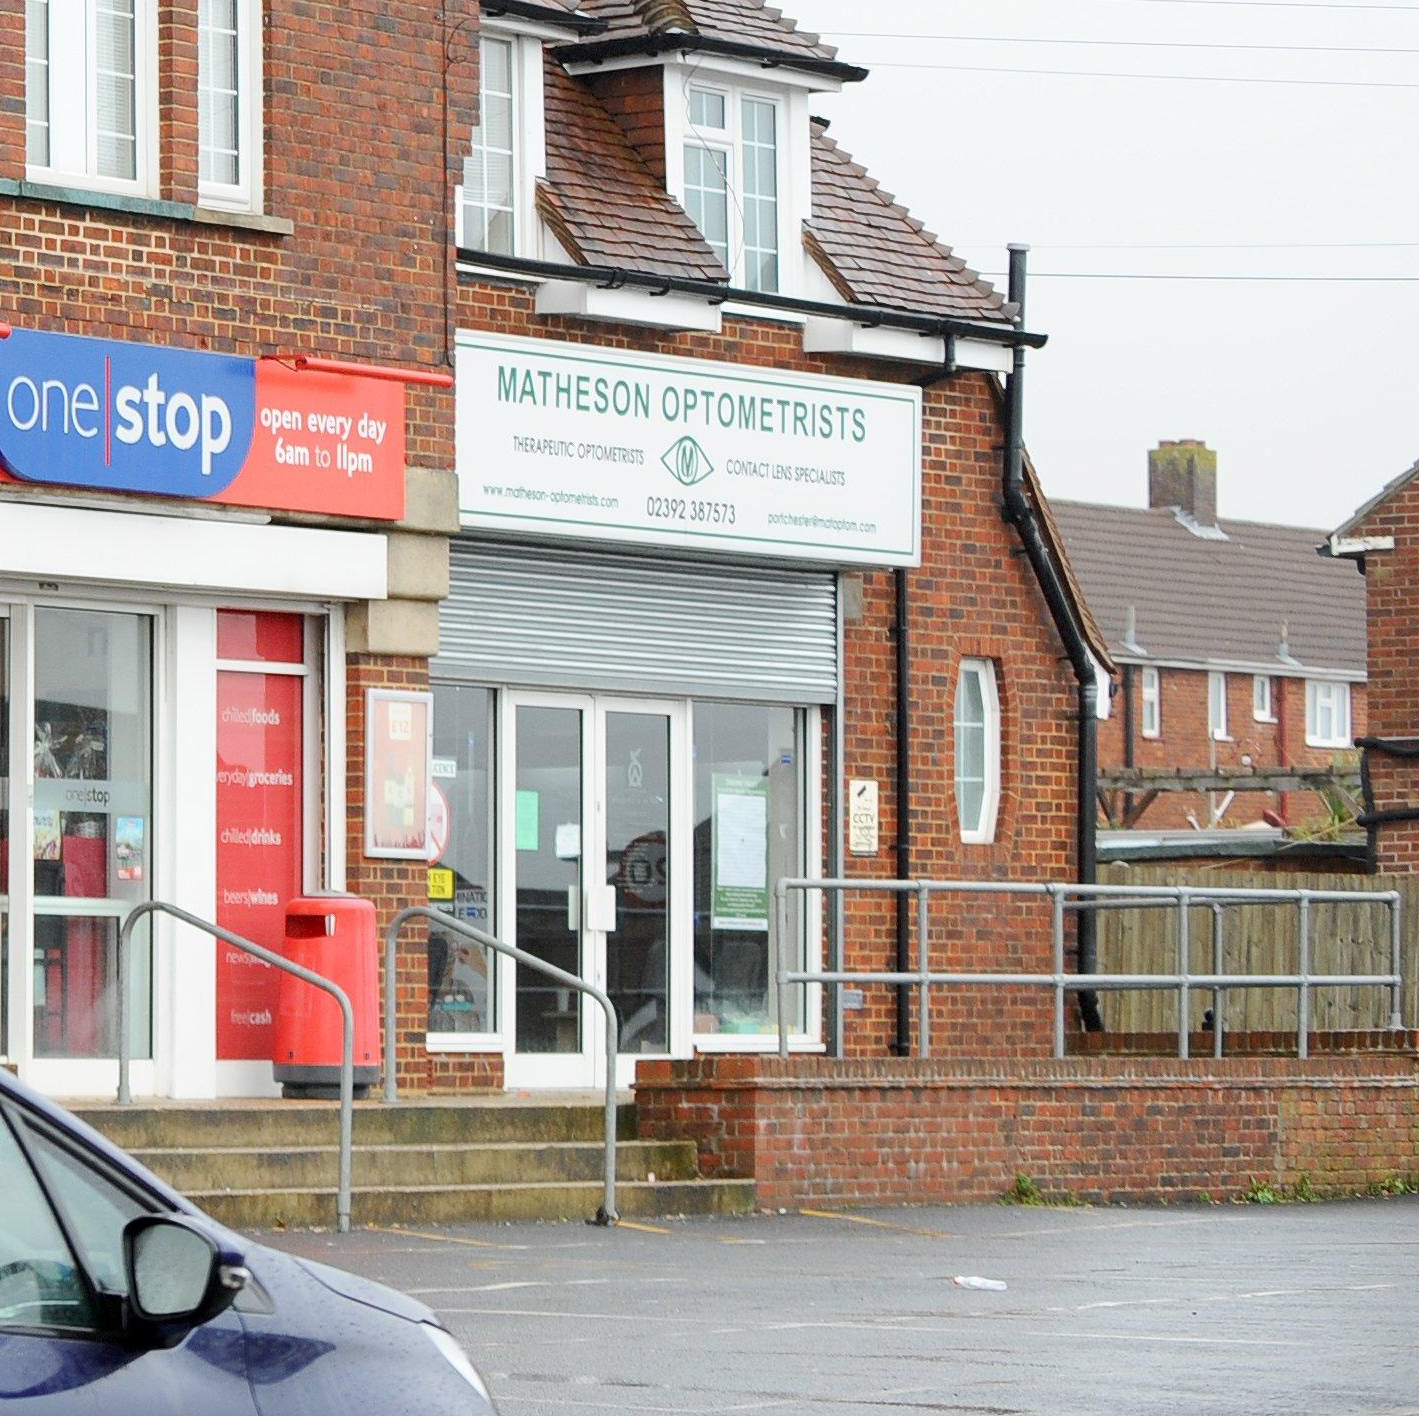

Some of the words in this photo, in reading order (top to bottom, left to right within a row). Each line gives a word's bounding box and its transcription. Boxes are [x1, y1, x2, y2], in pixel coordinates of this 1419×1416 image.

[497, 364, 651, 419] MATHESON
[661, 385, 866, 443] OPTOMETRISTS
[6, 374, 100, 440] one
[115, 372, 232, 475] stop
[260, 406, 304, 439] open
[306, 411, 355, 443] every
[357, 415, 387, 445] day
[274, 438, 310, 467] 6am
[313, 446, 332, 470] to
[335, 444, 374, 477] 11pm
[513, 435, 575, 458] THERAPEUTIC
[577, 442, 645, 466] OPTOMETRISTS
[726, 458, 770, 479] CONTACT
[772, 465, 793, 482] LENS
[794, 466, 846, 487] SPECIALISTS
[647, 496, 686, 520] 02392
[690, 501, 736, 525] 387573
[222, 708, 250, 724] chilled
[251, 708, 280, 725] foods
[248, 768, 293, 787] groceries
[66, 789, 84, 801] one
[86, 788, 110, 806] stop
[853, 813, 874, 824] CCTV
[221, 830, 249, 844] chilled
[250, 828, 282, 845] drinks
[223, 889, 248, 904] beers
[249, 888, 278, 906] wines
[249, 1008, 272, 1025] cash
